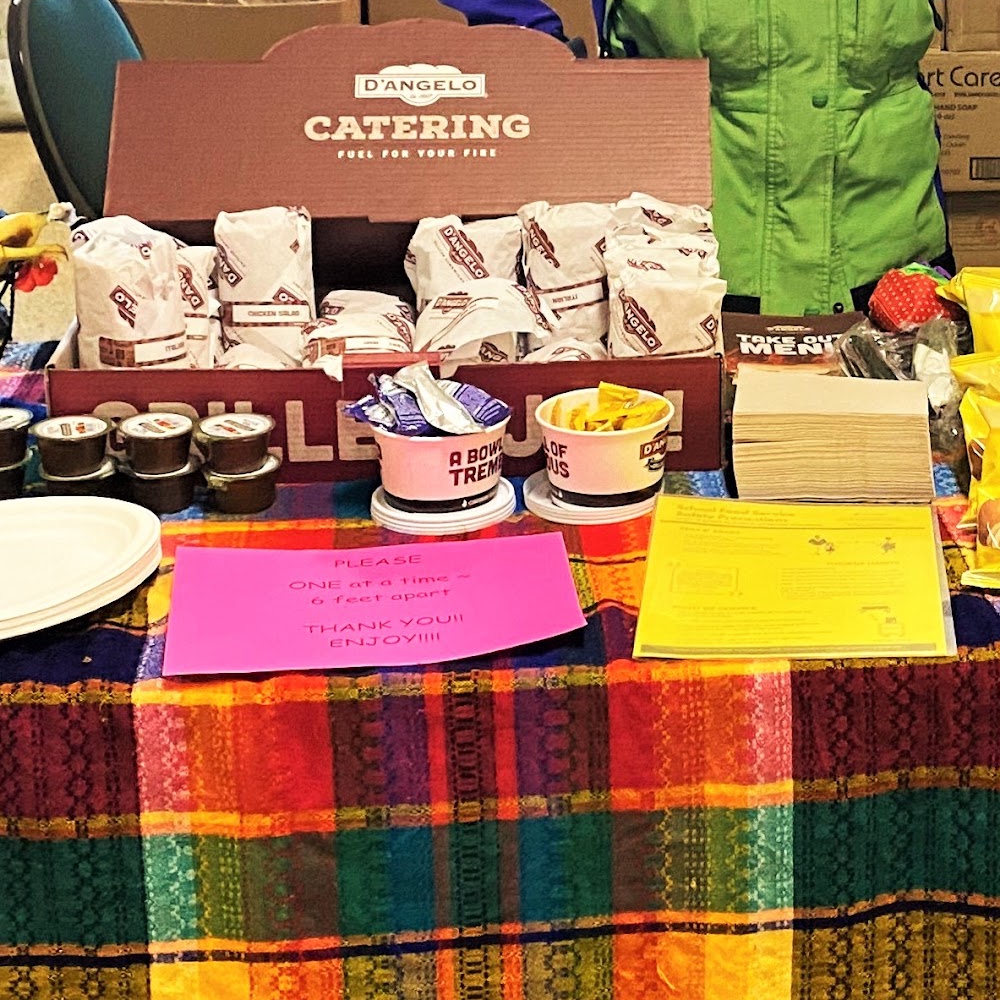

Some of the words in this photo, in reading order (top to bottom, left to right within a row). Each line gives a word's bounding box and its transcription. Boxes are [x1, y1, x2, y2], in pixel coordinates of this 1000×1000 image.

[364, 78, 477, 92] D'ANGELO
[303, 113, 531, 142] CATERING
[337, 149, 374, 160] FUEL
[381, 149, 409, 159] FOR
[417, 148, 456, 159] YOUR
[463, 148, 497, 158] FIRE
[736, 333, 797, 344] TAKE
[449, 451, 462, 467] A
[334, 554, 421, 568] PLEASE
[289, 580, 341, 590] ONE
[349, 579, 373, 588] at
[400, 574, 449, 585] time
[311, 595, 324, 605] 6
[334, 593, 383, 604] feet
[391, 588, 451, 603] apart
[302, 619, 392, 634] THANK
